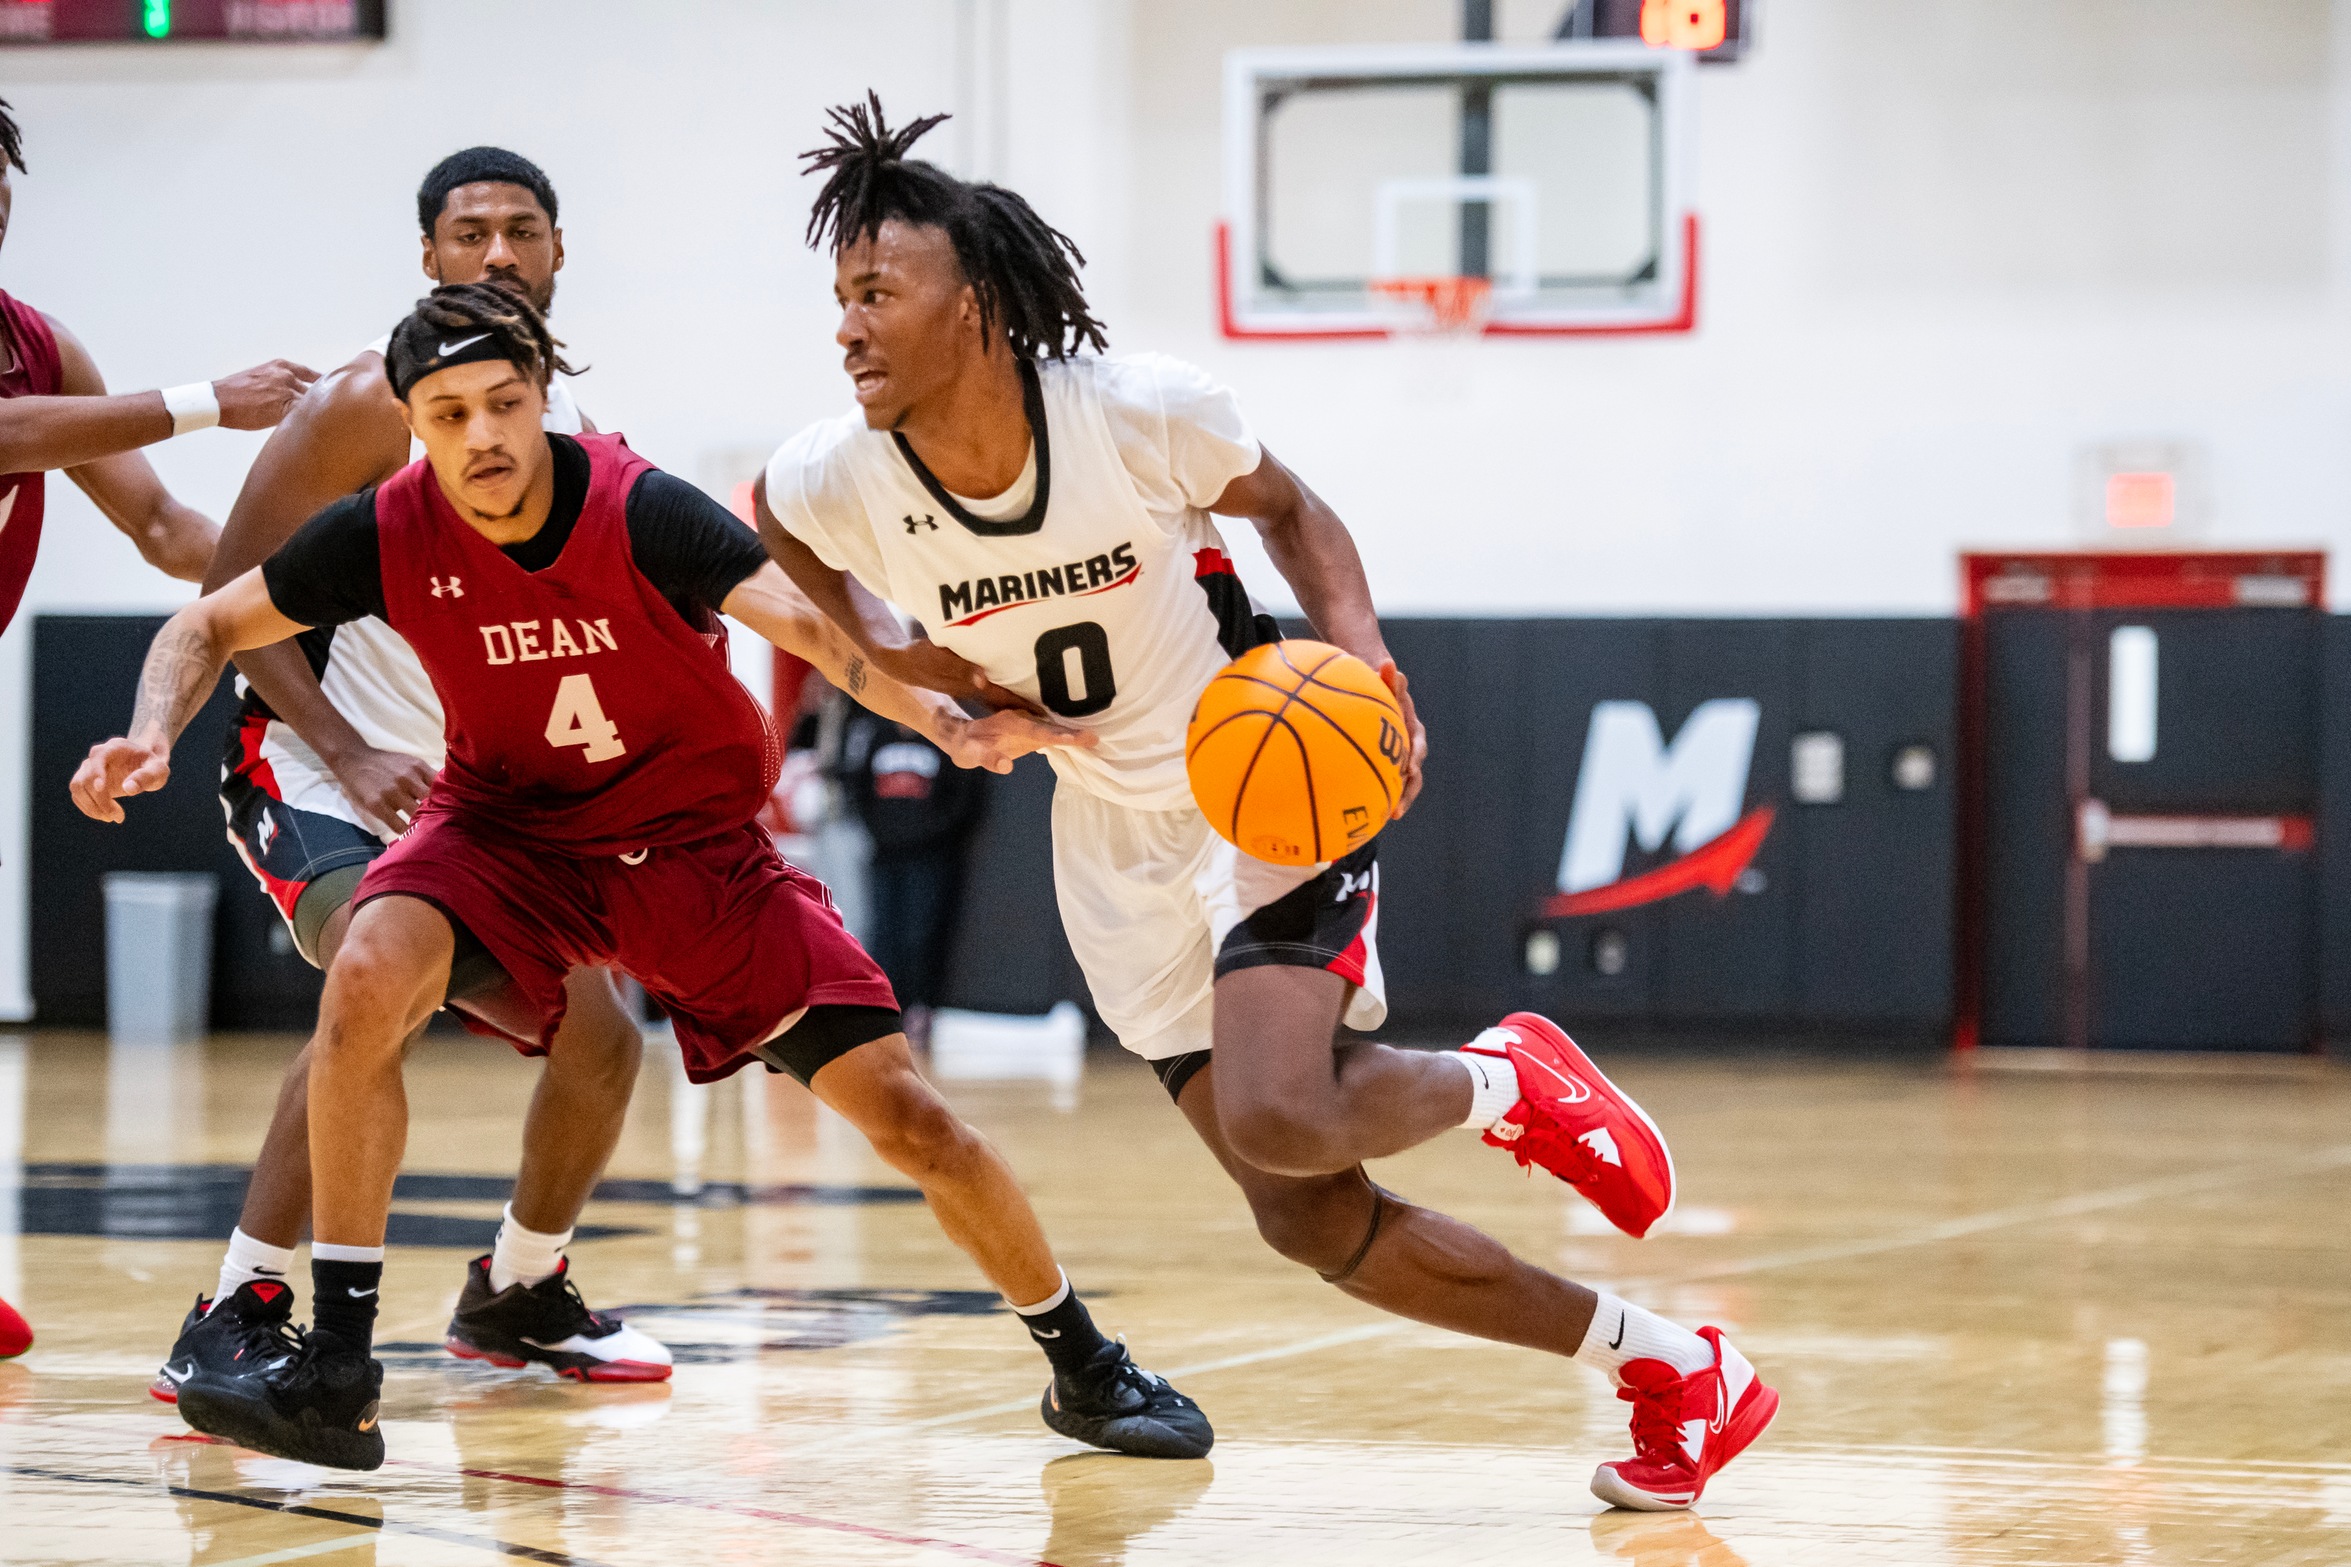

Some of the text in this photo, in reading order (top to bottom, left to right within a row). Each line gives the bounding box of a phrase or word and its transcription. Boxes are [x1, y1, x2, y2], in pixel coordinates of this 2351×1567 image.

[938, 541, 1137, 622] MARINERS
[479, 618, 619, 665] DEAN
[1033, 620, 1117, 718] 0
[544, 673, 627, 764] 4
[1555, 697, 1763, 896] M
